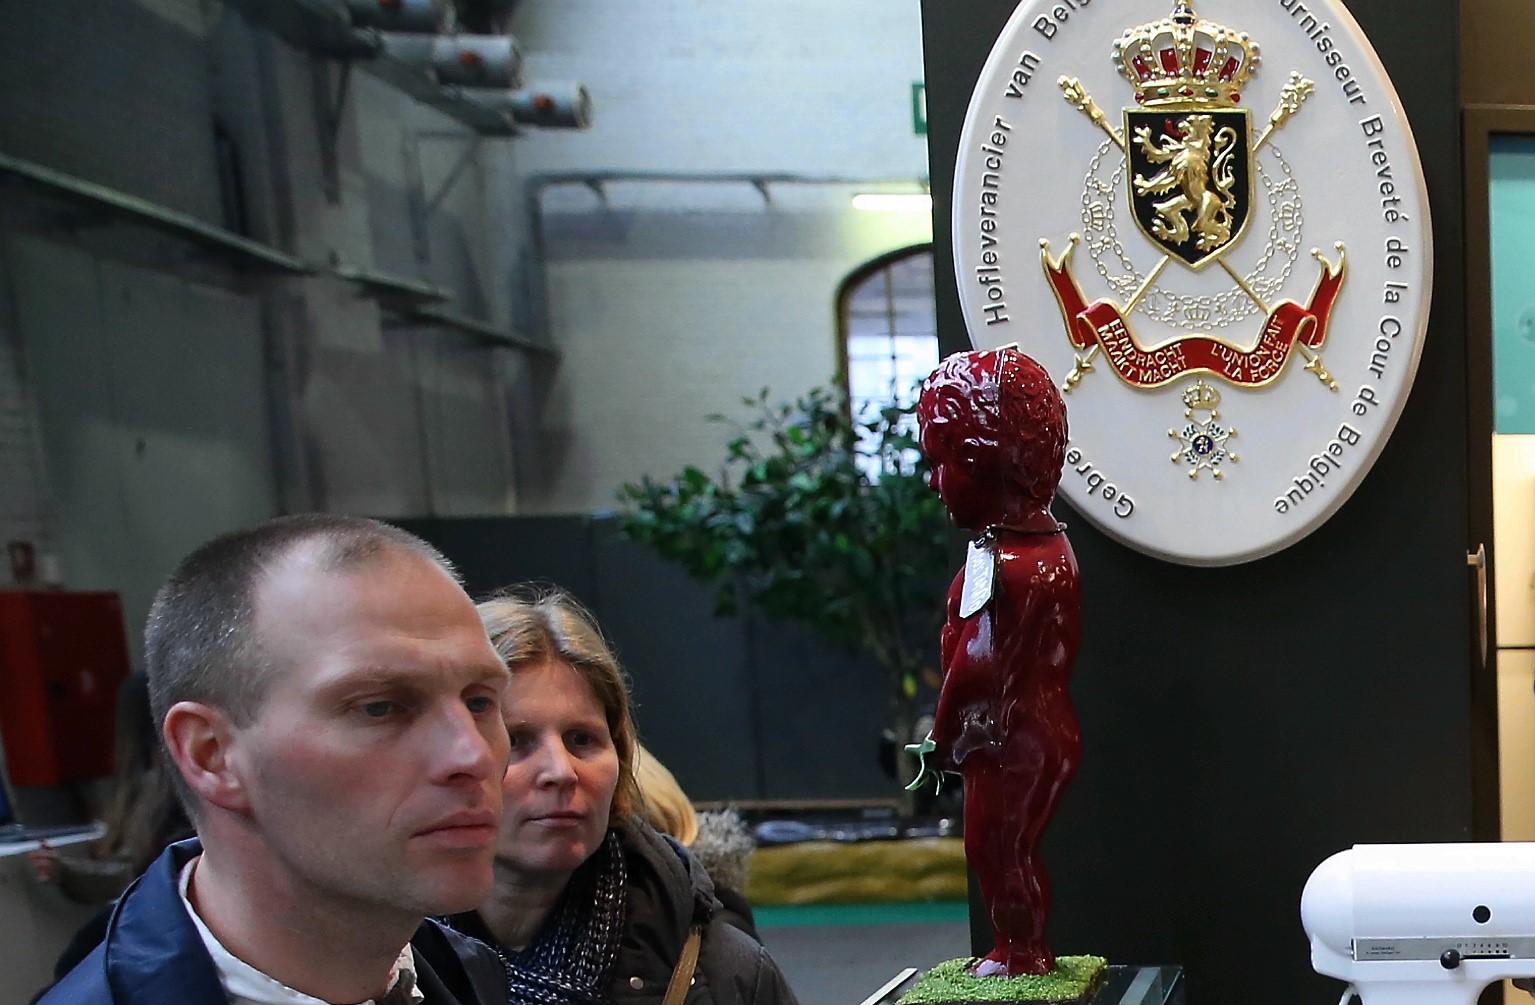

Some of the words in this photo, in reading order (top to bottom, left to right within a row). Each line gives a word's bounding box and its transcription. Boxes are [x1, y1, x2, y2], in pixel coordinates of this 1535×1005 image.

[1003, 50, 1041, 100] van
[1280, 0, 1366, 106] urnisseur
[1359, 113, 1409, 223] Breveté
[977, 114, 1013, 326] Hofleverancier
[1386, 236, 1409, 269] de
[1384, 281, 1408, 305] la
[1097, 324, 1137, 378] MAAKT
[1138, 356, 1188, 383] MACHT
[1109, 318, 1183, 369] EENDRACHT
[1211, 342, 1269, 369] L'UNION
[1265, 314, 1285, 346] FAIT
[1223, 362, 1243, 381] LA
[1251, 340, 1290, 382] FORCE
[1368, 315, 1402, 380] Cour
[1352, 384, 1379, 417] de
[1066, 450, 1134, 518] Gebre
[1274, 422, 1362, 515] Belgique
